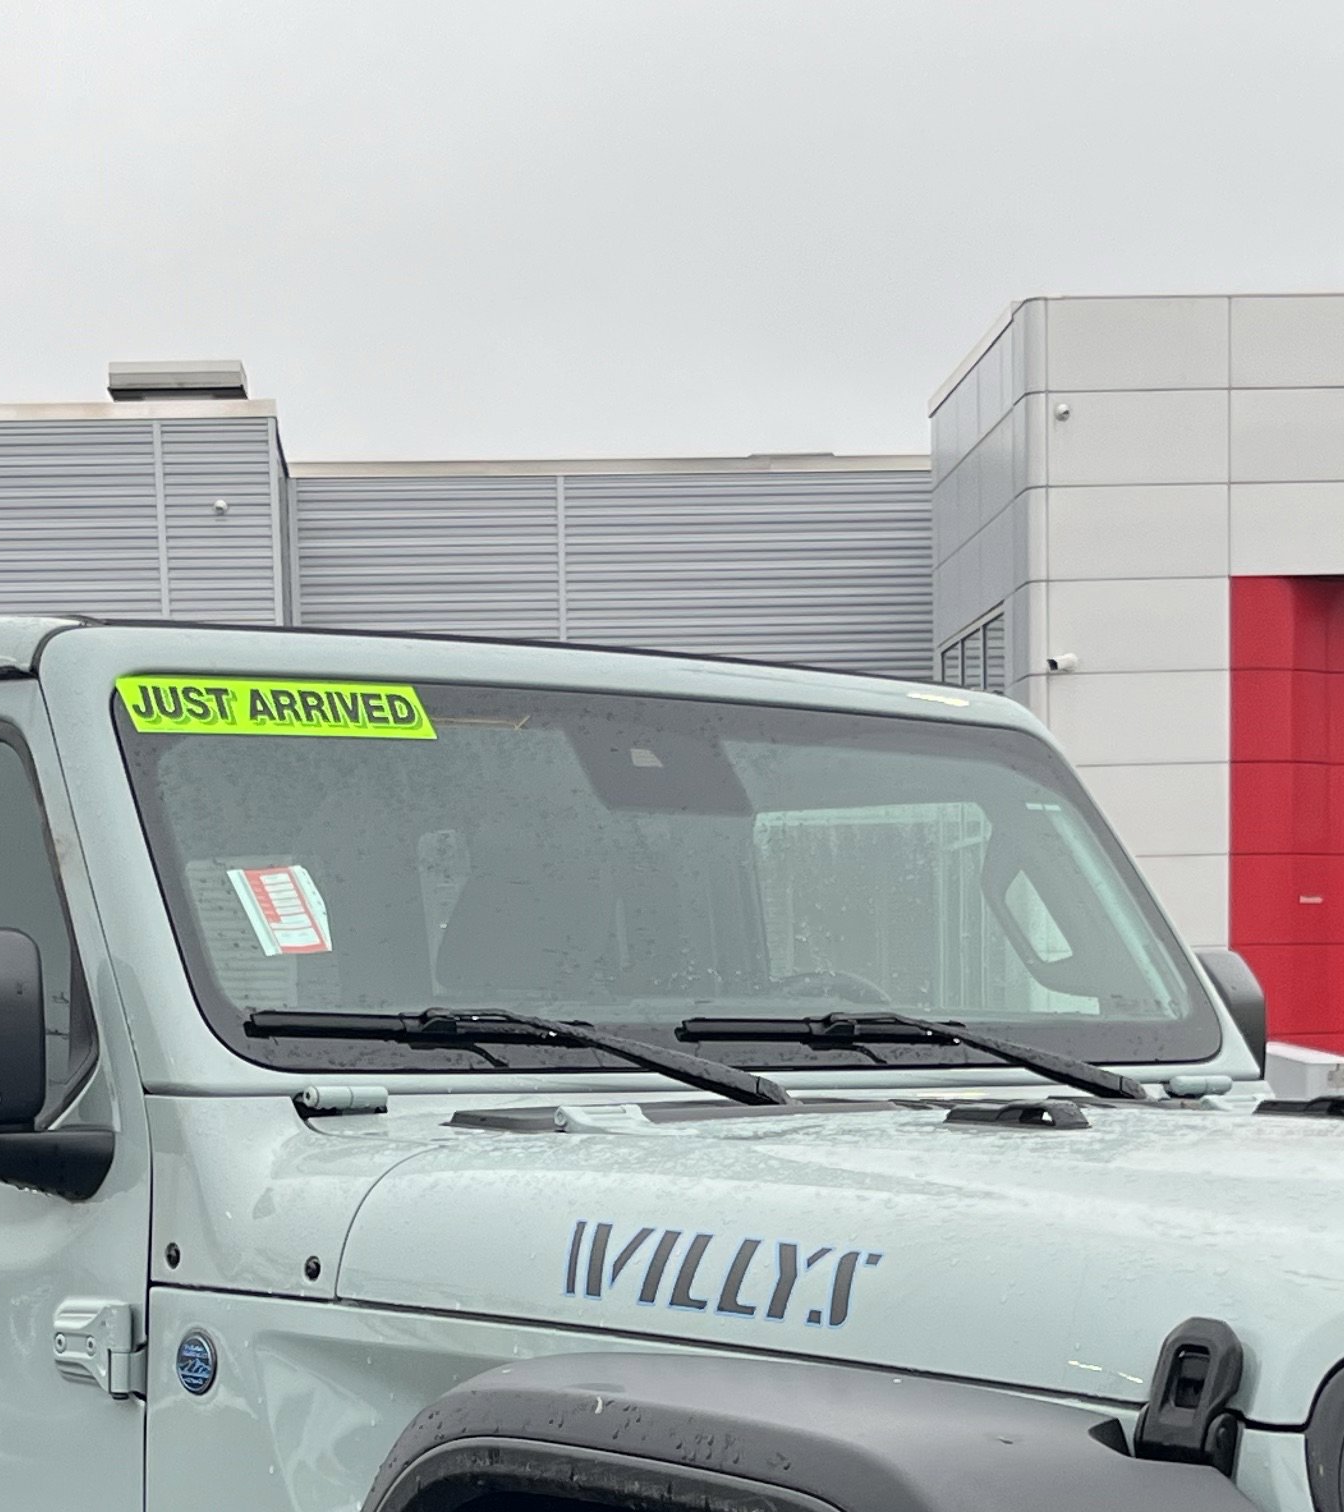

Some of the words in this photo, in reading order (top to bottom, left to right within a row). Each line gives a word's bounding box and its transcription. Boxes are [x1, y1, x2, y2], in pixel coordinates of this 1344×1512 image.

[132, 685, 232, 724] JUST
[249, 688, 423, 729] ARRIVED
[564, 1219, 883, 1328] WILLYS
